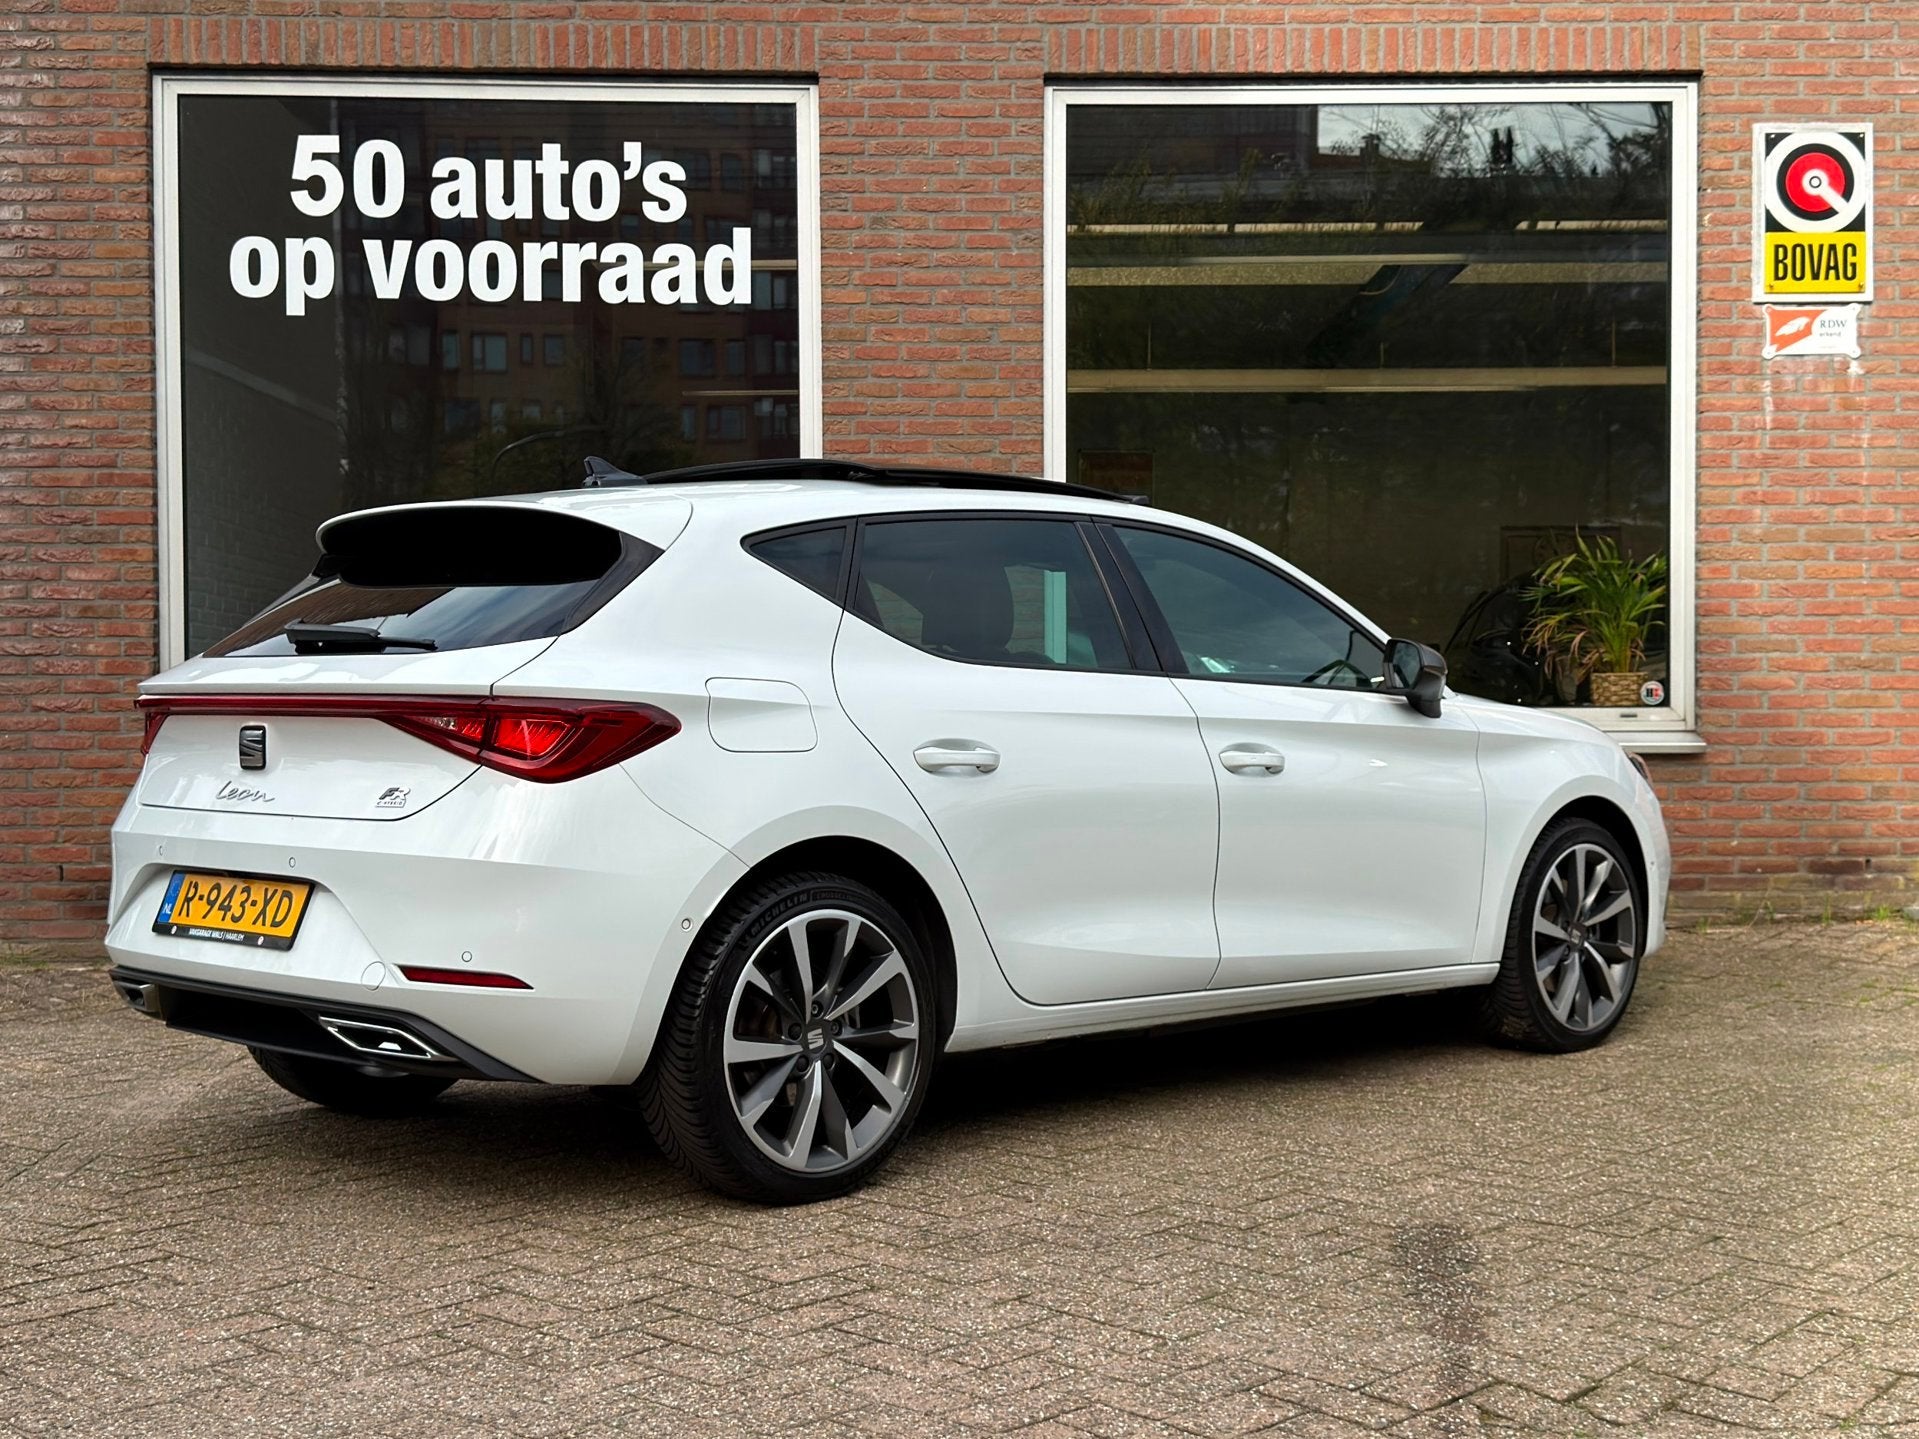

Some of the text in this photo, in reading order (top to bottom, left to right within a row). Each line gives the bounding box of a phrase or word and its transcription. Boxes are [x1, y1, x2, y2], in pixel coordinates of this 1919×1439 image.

[290, 134, 405, 218] 50
[229, 227, 752, 316] op voorraad
[1773, 243, 1857, 282] BOVAG
[1820, 319, 1848, 328] RDW
[163, 902, 172, 914] NL
[178, 880, 294, 928] R-943-XD
[751, 892, 809, 937] MICHELIN
